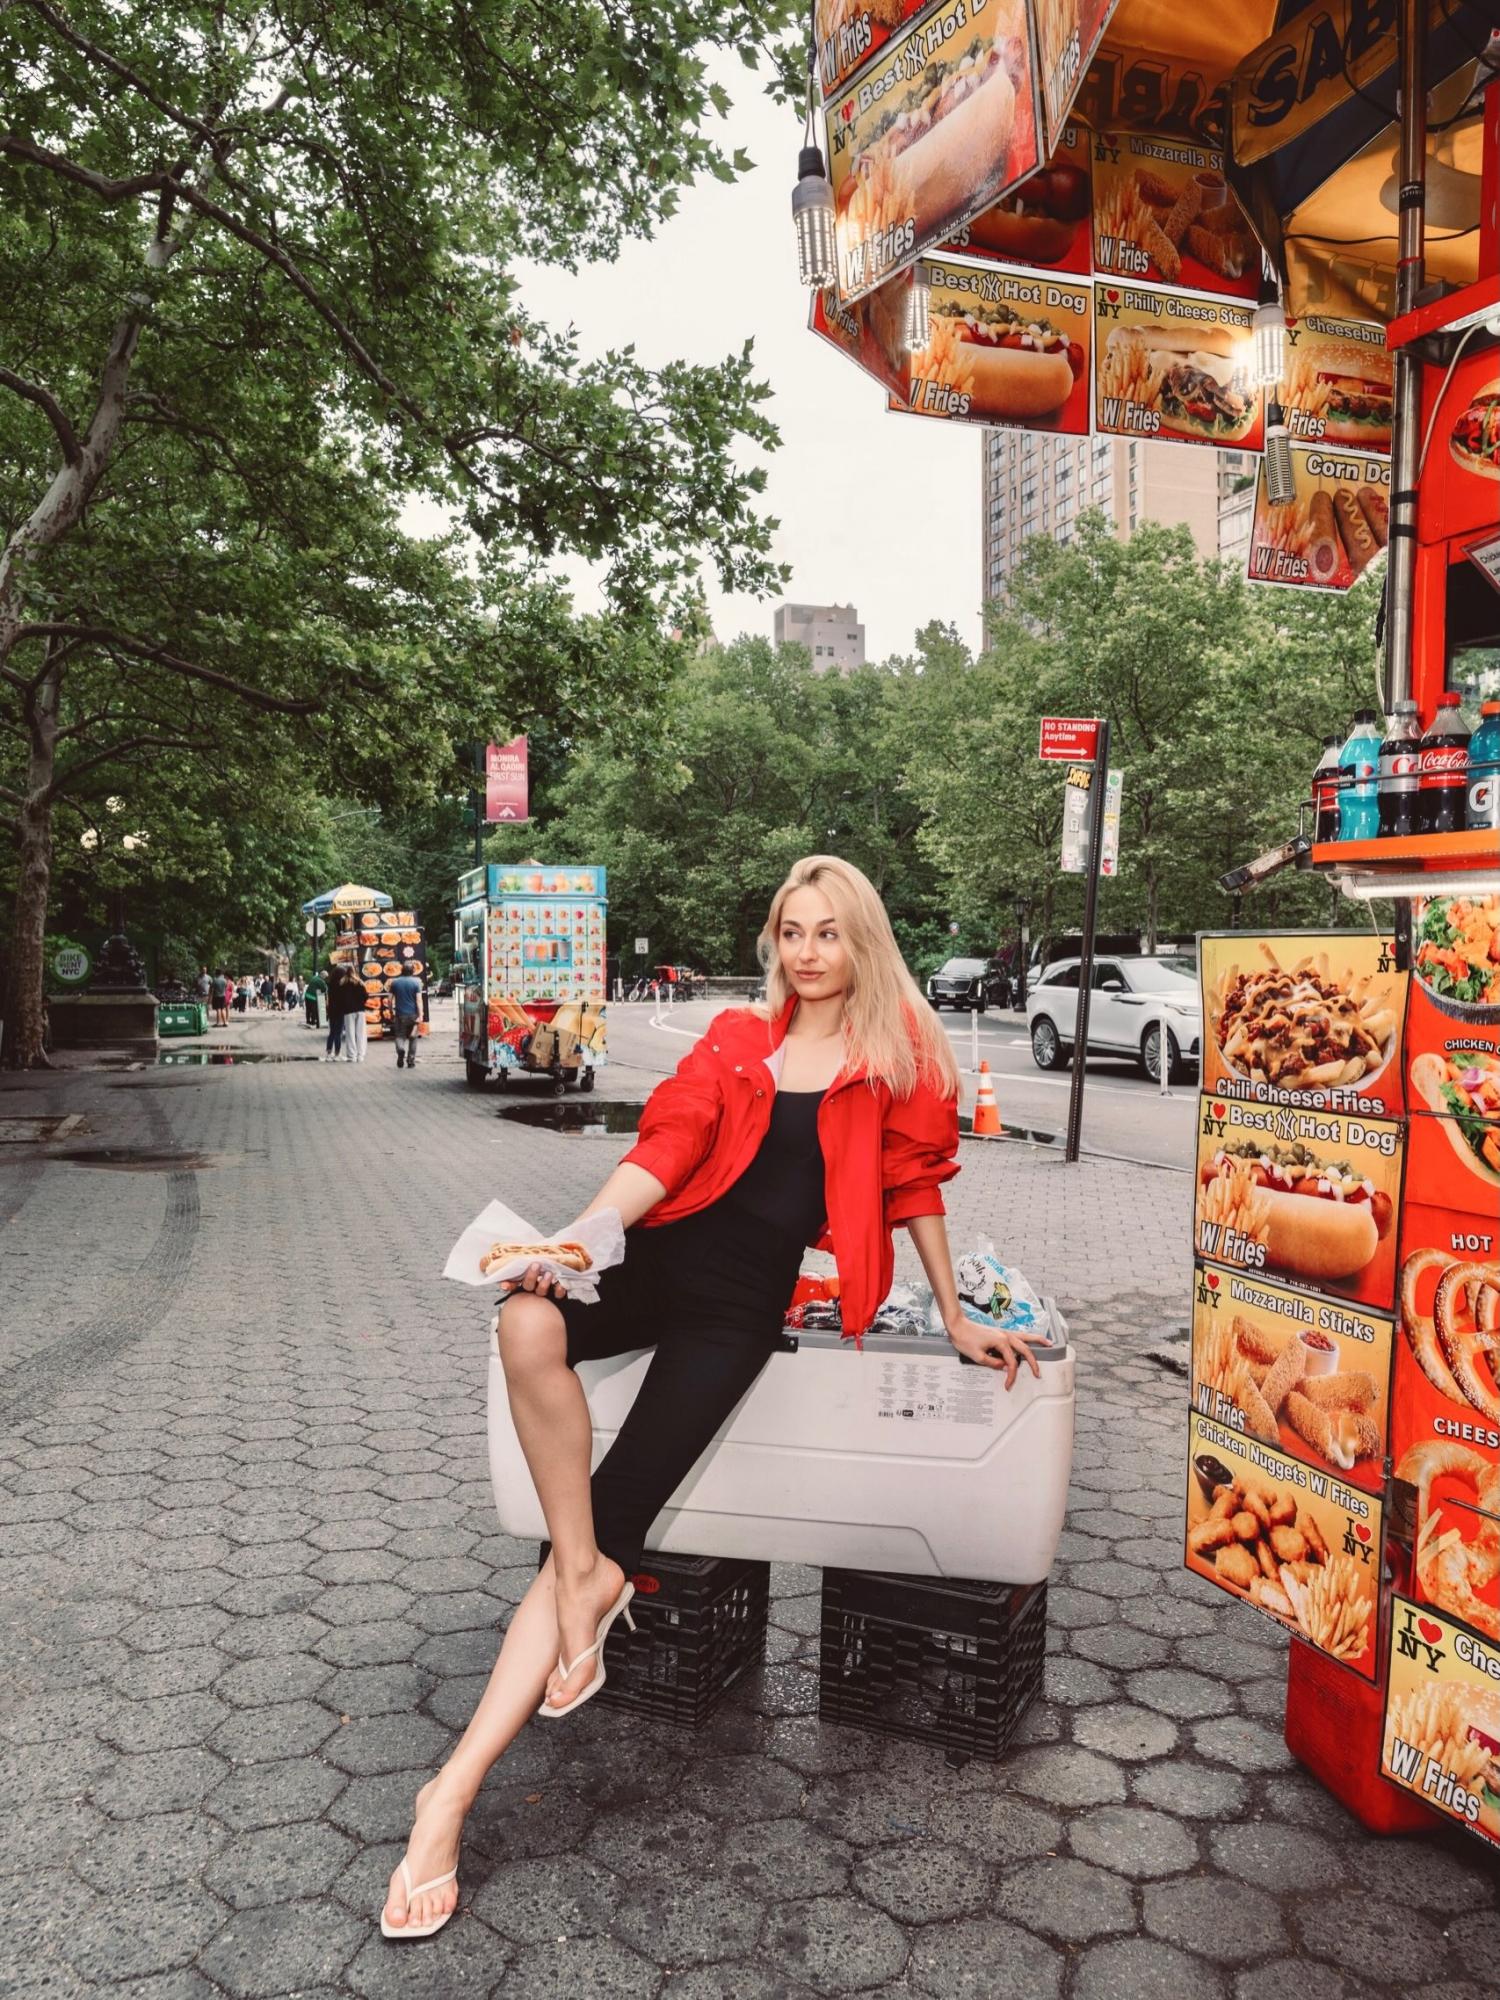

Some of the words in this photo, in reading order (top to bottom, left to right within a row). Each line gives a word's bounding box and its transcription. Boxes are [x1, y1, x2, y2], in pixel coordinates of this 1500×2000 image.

[840, 11, 872, 70] Fries
[859, 54, 904, 115] Best
[926, 3, 966, 55] Hot
[1129, 136, 1206, 168] Mozzarella
[872, 217, 915, 273] Fries
[1100, 236, 1115, 268] W/
[1118, 240, 1149, 273] Fries
[931, 266, 979, 294] Best
[979, 272, 1002, 302] NY
[1004, 281, 1043, 306] Hot
[1046, 288, 1087, 315] Dog
[1124, 291, 1163, 316] Philly
[1166, 298, 1217, 322] Cheese
[1098, 302, 1121, 319] NY
[924, 379, 970, 414] Fries
[1104, 397, 1121, 428] W/
[1123, 400, 1162, 432] Fries
[1289, 407, 1326, 438] Fries
[1306, 454, 1360, 480] Corn
[1256, 546, 1274, 576] W/
[1274, 548, 1309, 578] Fries
[1044, 722, 1056, 731] NO
[1058, 723, 1096, 732] STANDING
[1044, 732, 1076, 742] Anytime
[1469, 781, 1493, 812] G
[60, 953, 80, 961] BIKE
[62, 968, 80, 976] NYC
[1377, 958, 1402, 973] N
[1444, 1038, 1495, 1053] CHICKEN
[1206, 1101, 1214, 1118] I
[1216, 1078, 1251, 1100] Chili
[1254, 1083, 1326, 1110] Cheese
[1330, 1089, 1386, 1115] Fries
[1203, 1118, 1228, 1138] NY
[1229, 1105, 1275, 1132] Best
[1275, 1108, 1298, 1142] NY
[1299, 1116, 1340, 1143] Hot
[1347, 1123, 1397, 1156] Dog
[1200, 1220, 1221, 1254] W/
[1223, 1227, 1266, 1268] Fries
[1450, 1234, 1492, 1252] HOT
[1197, 1286, 1222, 1309] NY
[1230, 1278, 1315, 1325] Mozzarella
[1318, 1306, 1376, 1344] Sticks
[1199, 1383, 1212, 1416] W/
[1215, 1390, 1245, 1432] Fries
[1433, 1416, 1500, 1449] CHEES
[1196, 1420, 1246, 1458] Chicken
[1250, 1443, 1307, 1487] Nuggets
[1308, 1471, 1328, 1498] W/
[1331, 1483, 1368, 1518] Fries
[1346, 1516, 1355, 1537] I
[1342, 1534, 1374, 1564] NY
[1403, 1608, 1416, 1636] I
[1396, 1630, 1446, 1674] NY
[1454, 1634, 1500, 1680] Che
[1391, 1736, 1424, 1784] W/
[1422, 1757, 1480, 1822] Fries
